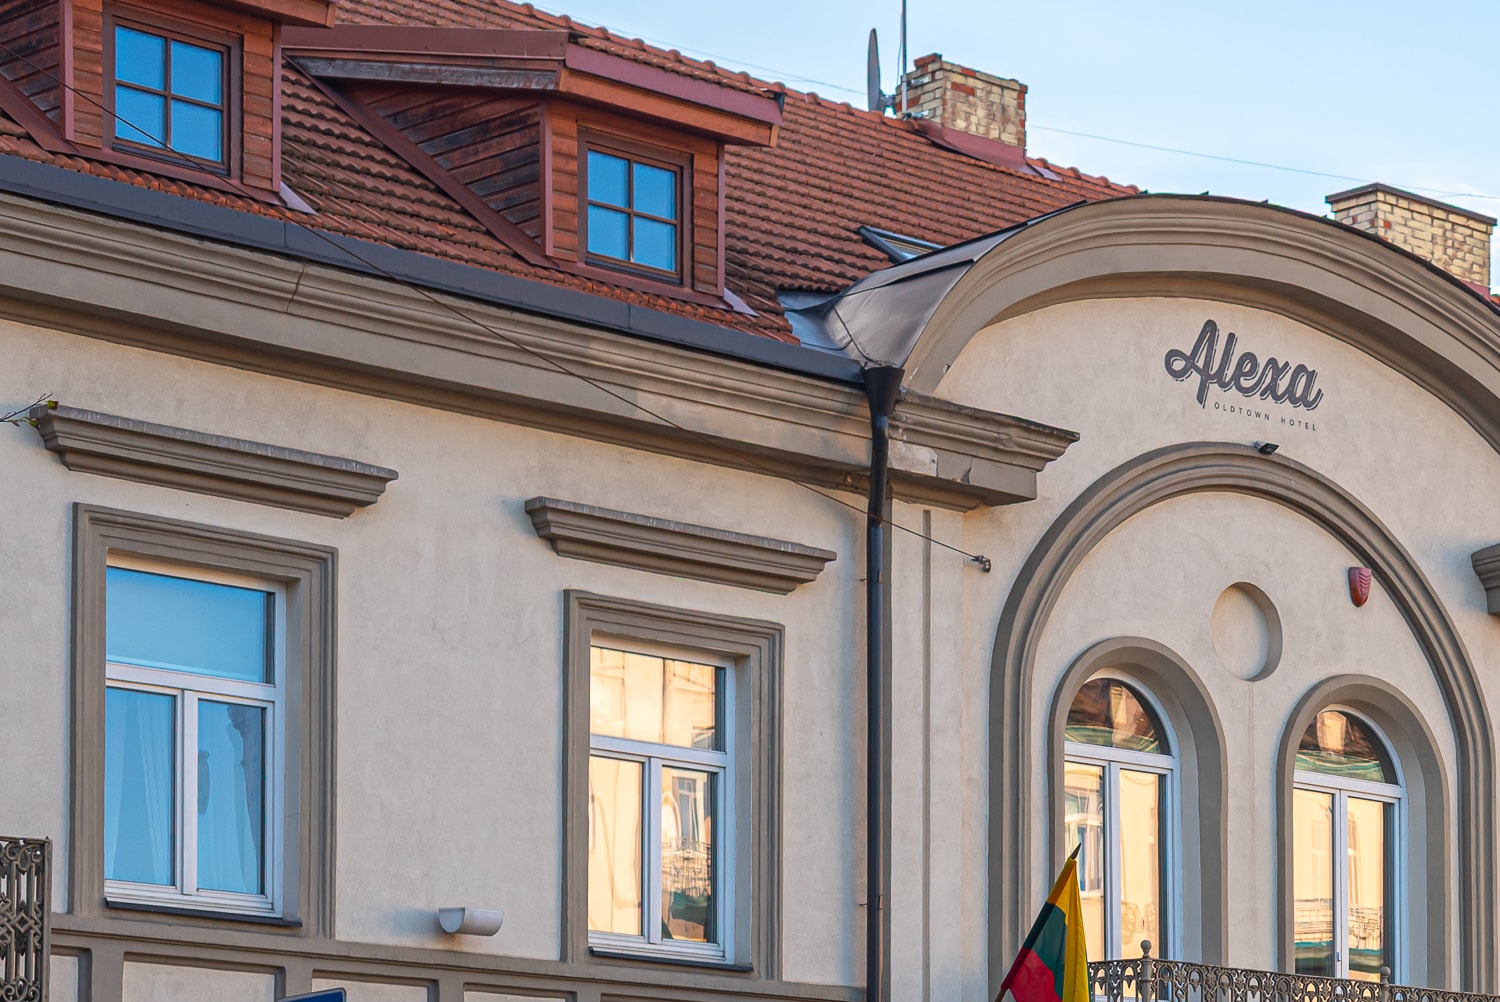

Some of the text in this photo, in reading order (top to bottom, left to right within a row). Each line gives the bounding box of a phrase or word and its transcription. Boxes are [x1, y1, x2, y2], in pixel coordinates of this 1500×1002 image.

[1164, 319, 1323, 411] Alexa
[1214, 401, 1317, 432] OLDTOWN HOTEL
